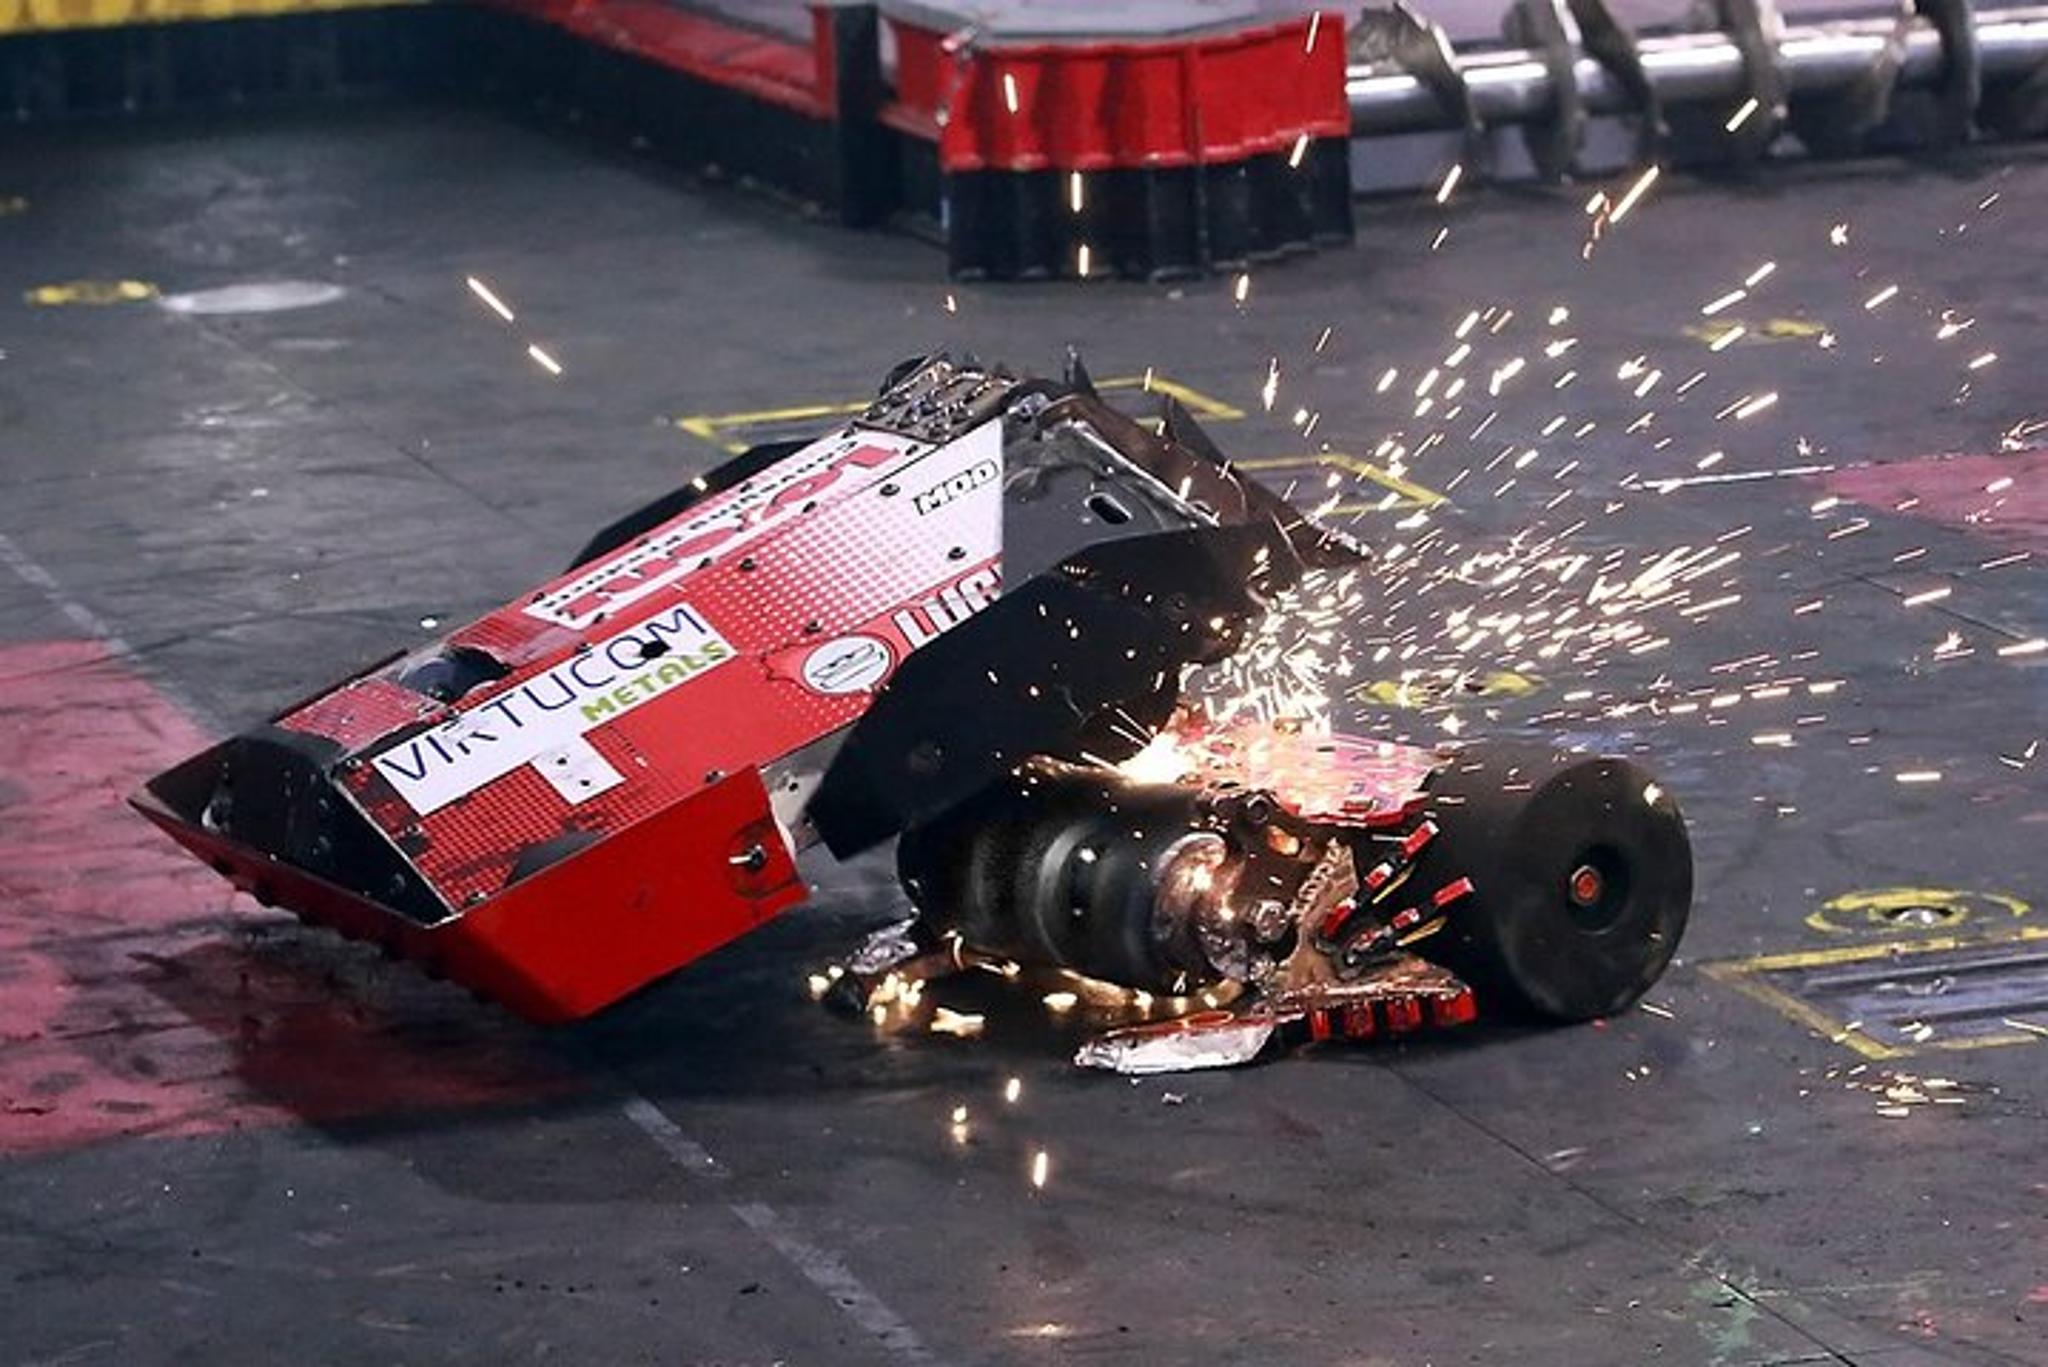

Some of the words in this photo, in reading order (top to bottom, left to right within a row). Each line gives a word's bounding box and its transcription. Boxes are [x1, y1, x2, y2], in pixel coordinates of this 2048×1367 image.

[914, 459, 999, 515] MOD
[893, 563, 1001, 650] LUC
[579, 639, 732, 723] METALS
